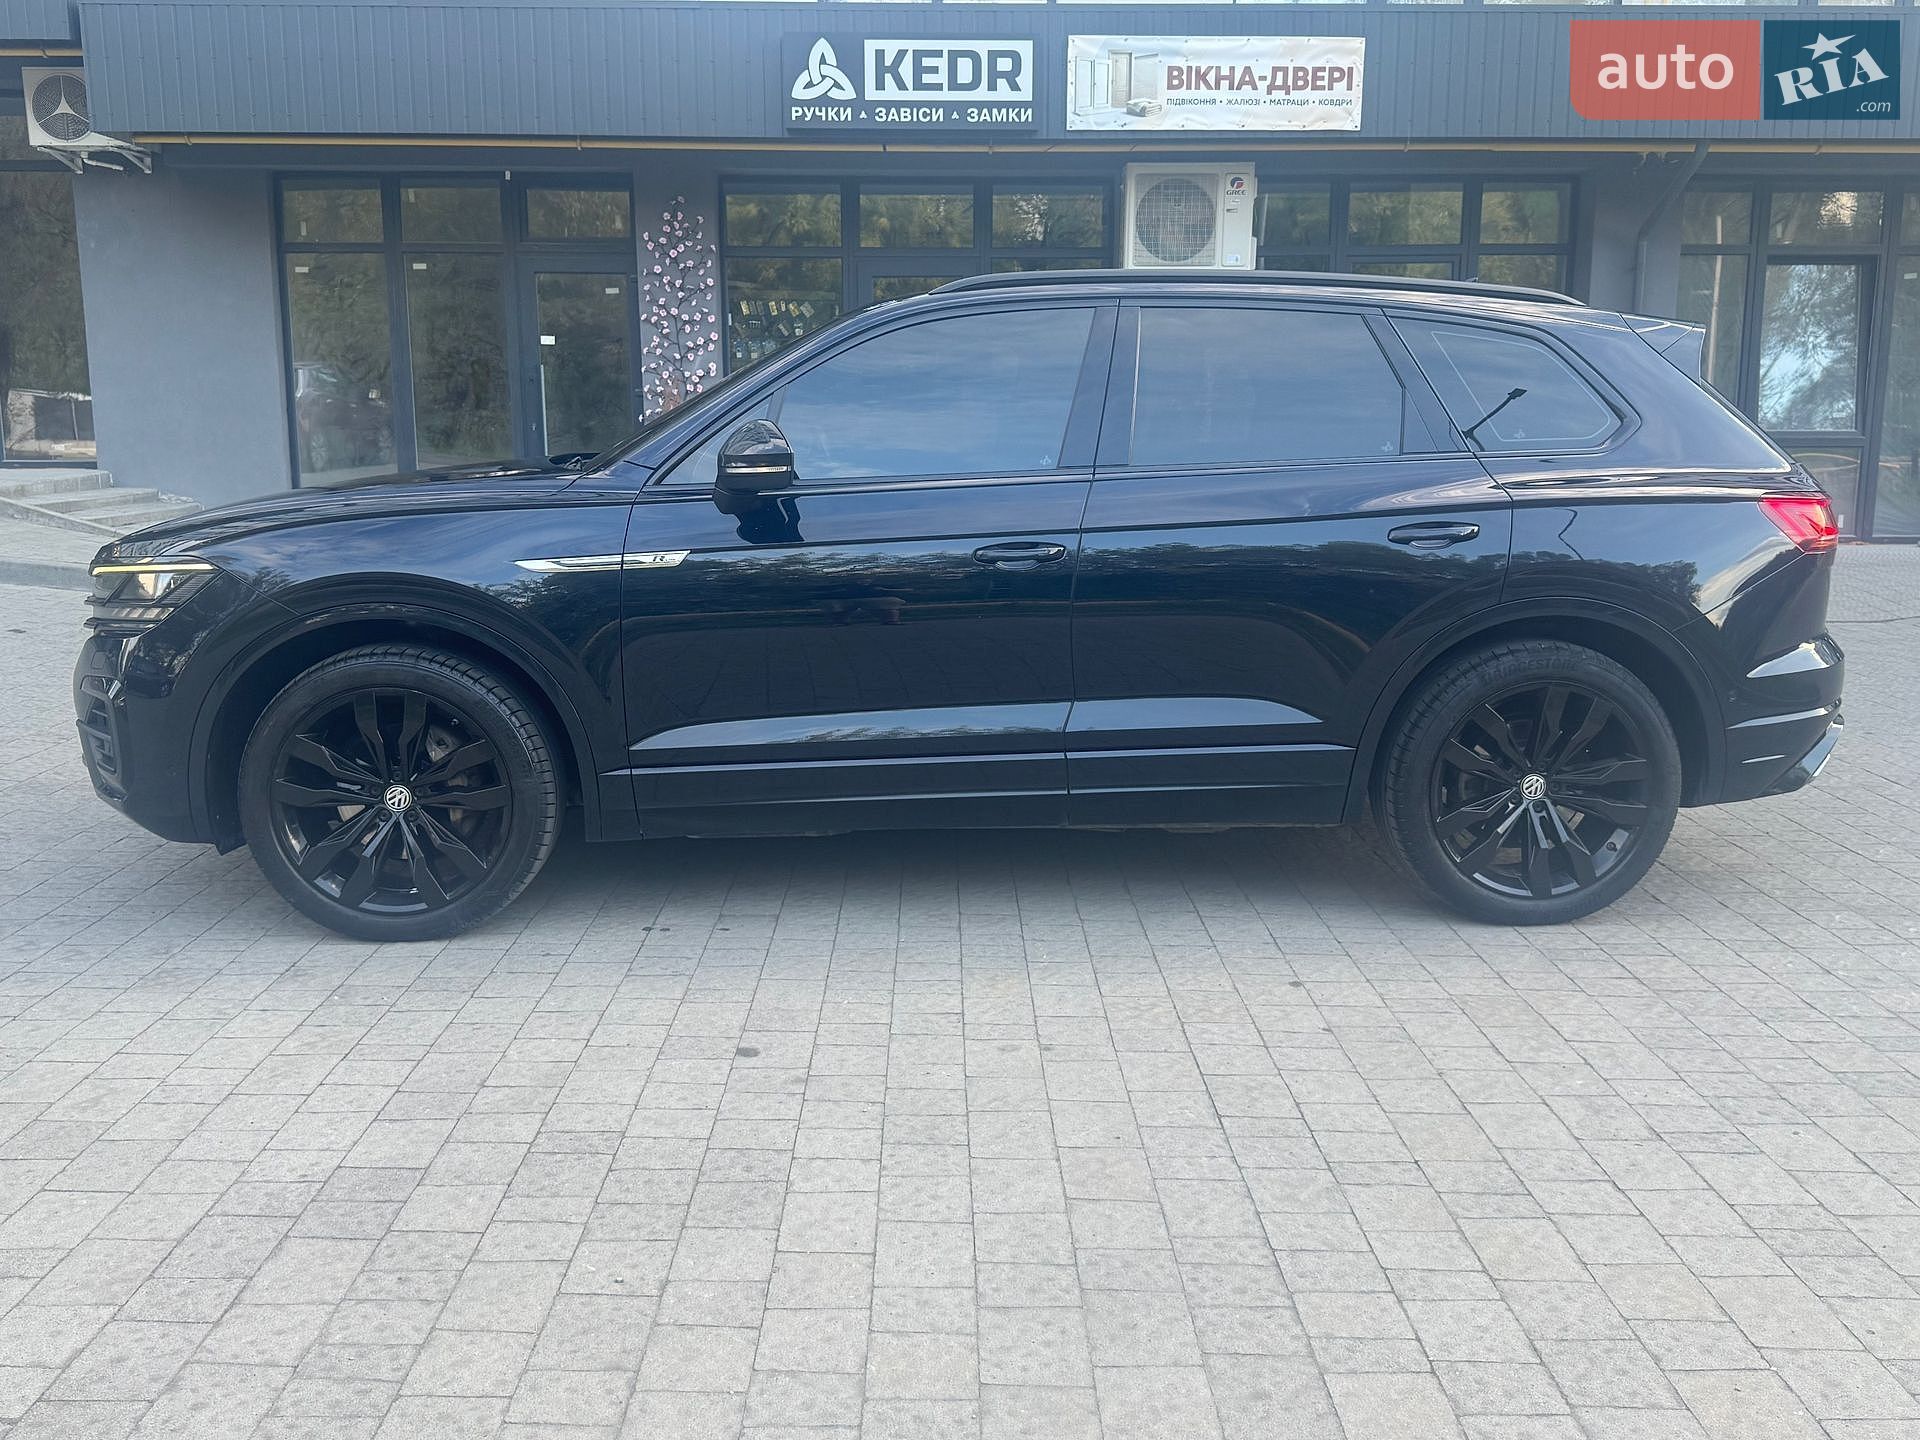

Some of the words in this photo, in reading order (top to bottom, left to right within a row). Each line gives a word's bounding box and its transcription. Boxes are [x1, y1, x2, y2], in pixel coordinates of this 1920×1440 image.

[874, 48, 1022, 92] KEDR
[1166, 65, 1353, 95] ВІКНА-ДВЕРІ
[1166, 98, 1217, 106] ПІДВІКОННЯ
[1226, 98, 1261, 106] ЖАЛЮЗІ
[1269, 98, 1309, 106] МАТРАЦИ
[1318, 98, 1353, 106] КОВДРИ
[791, 106, 852, 121] РУЧКИ
[874, 107, 944, 122] ЗАВІСИ
[966, 107, 1033, 122] ЗАМКИ
